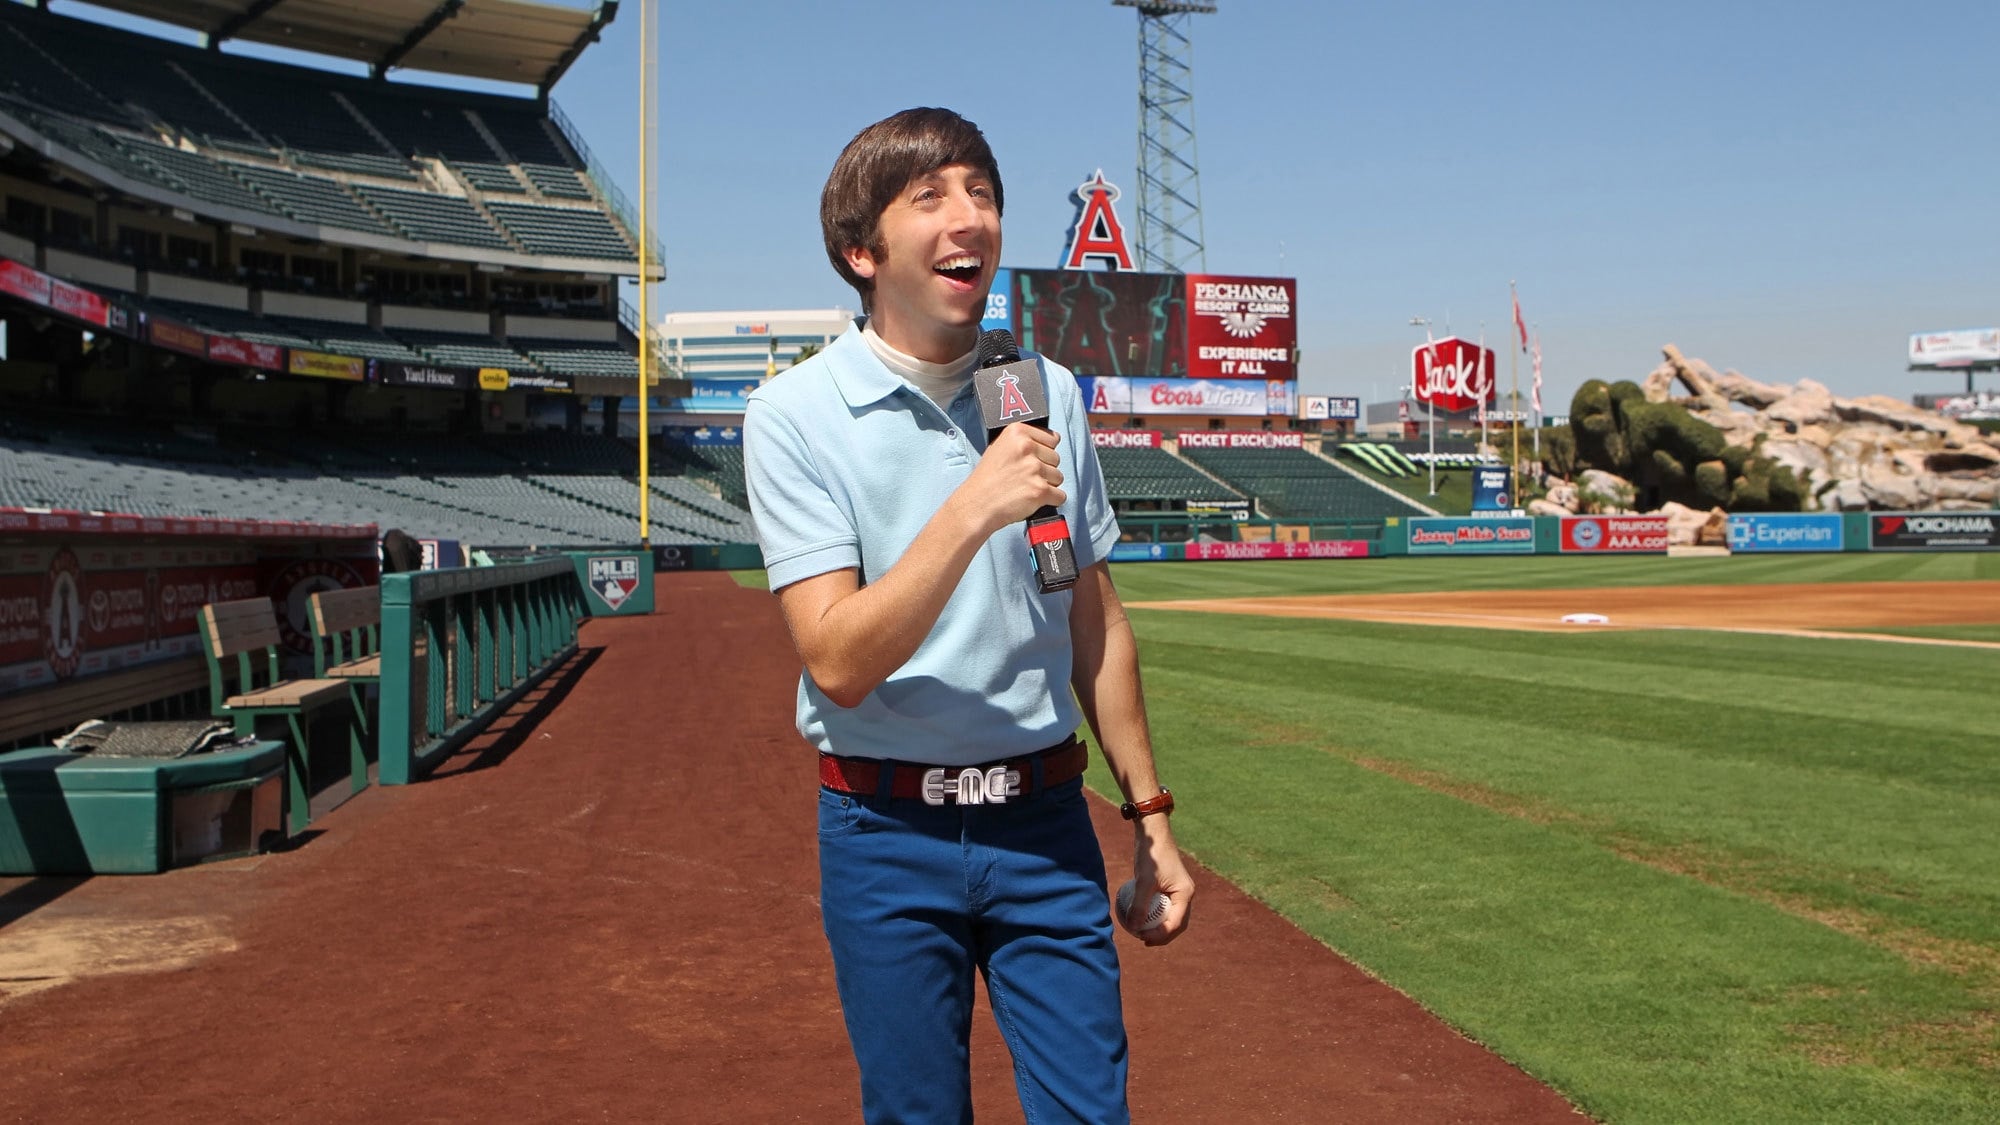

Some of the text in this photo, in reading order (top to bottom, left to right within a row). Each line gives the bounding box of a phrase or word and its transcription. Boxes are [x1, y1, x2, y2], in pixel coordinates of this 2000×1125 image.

[1195, 283, 1289, 301] PECHANGA
[1195, 301, 1290, 314] RESORT CASINO
[1199, 346, 1287, 361] EXPERIENCE
[403, 367, 455, 385] Yard House
[1221, 361, 1266, 375] IT ALL
[1418, 345, 1493, 399] Jack
[1151, 383, 1204, 405] Coors
[1203, 391, 1257, 406] LIGHT
[1179, 434, 1227, 447] TICKET
[1905, 517, 1994, 533] YOKOHAMA
[1757, 523, 1832, 544] Experian
[592, 561, 636, 576] MLB
